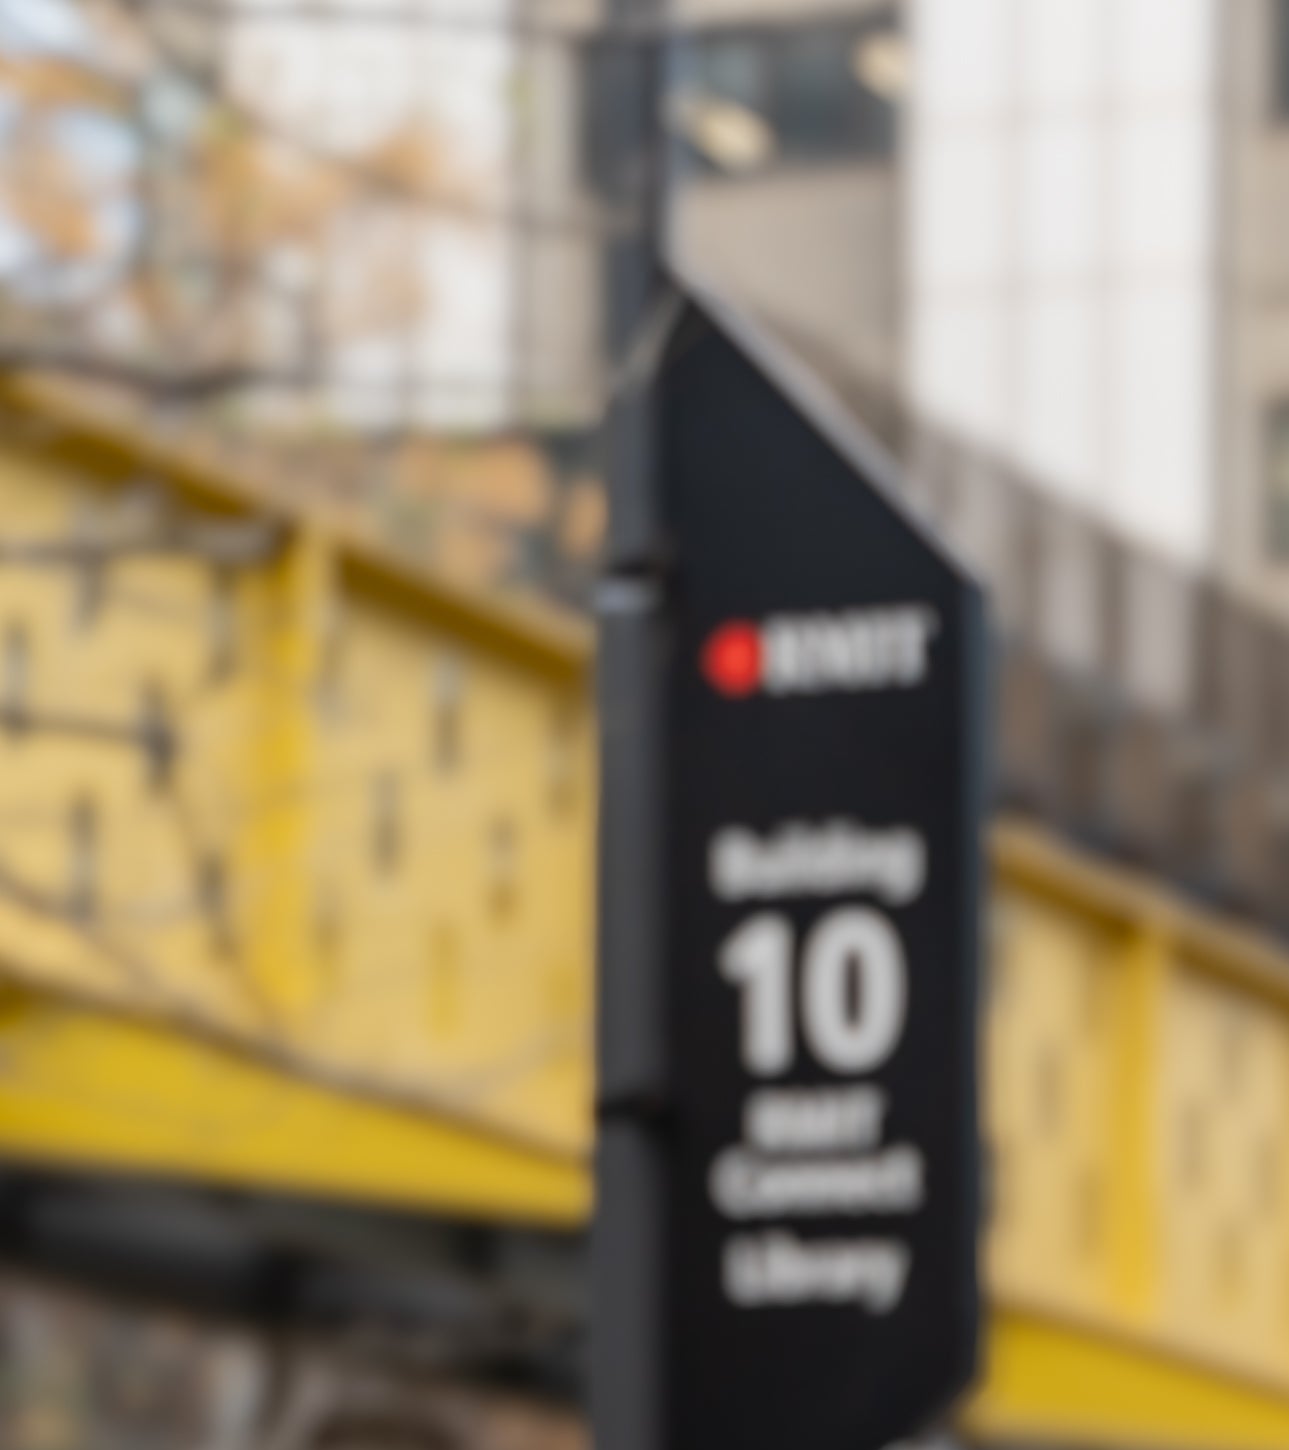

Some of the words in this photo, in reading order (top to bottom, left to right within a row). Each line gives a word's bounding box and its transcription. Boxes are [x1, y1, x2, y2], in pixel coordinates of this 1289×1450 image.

[712, 822, 926, 902] Building
[720, 906, 907, 1075] 10
[726, 1234, 908, 1310] Library
